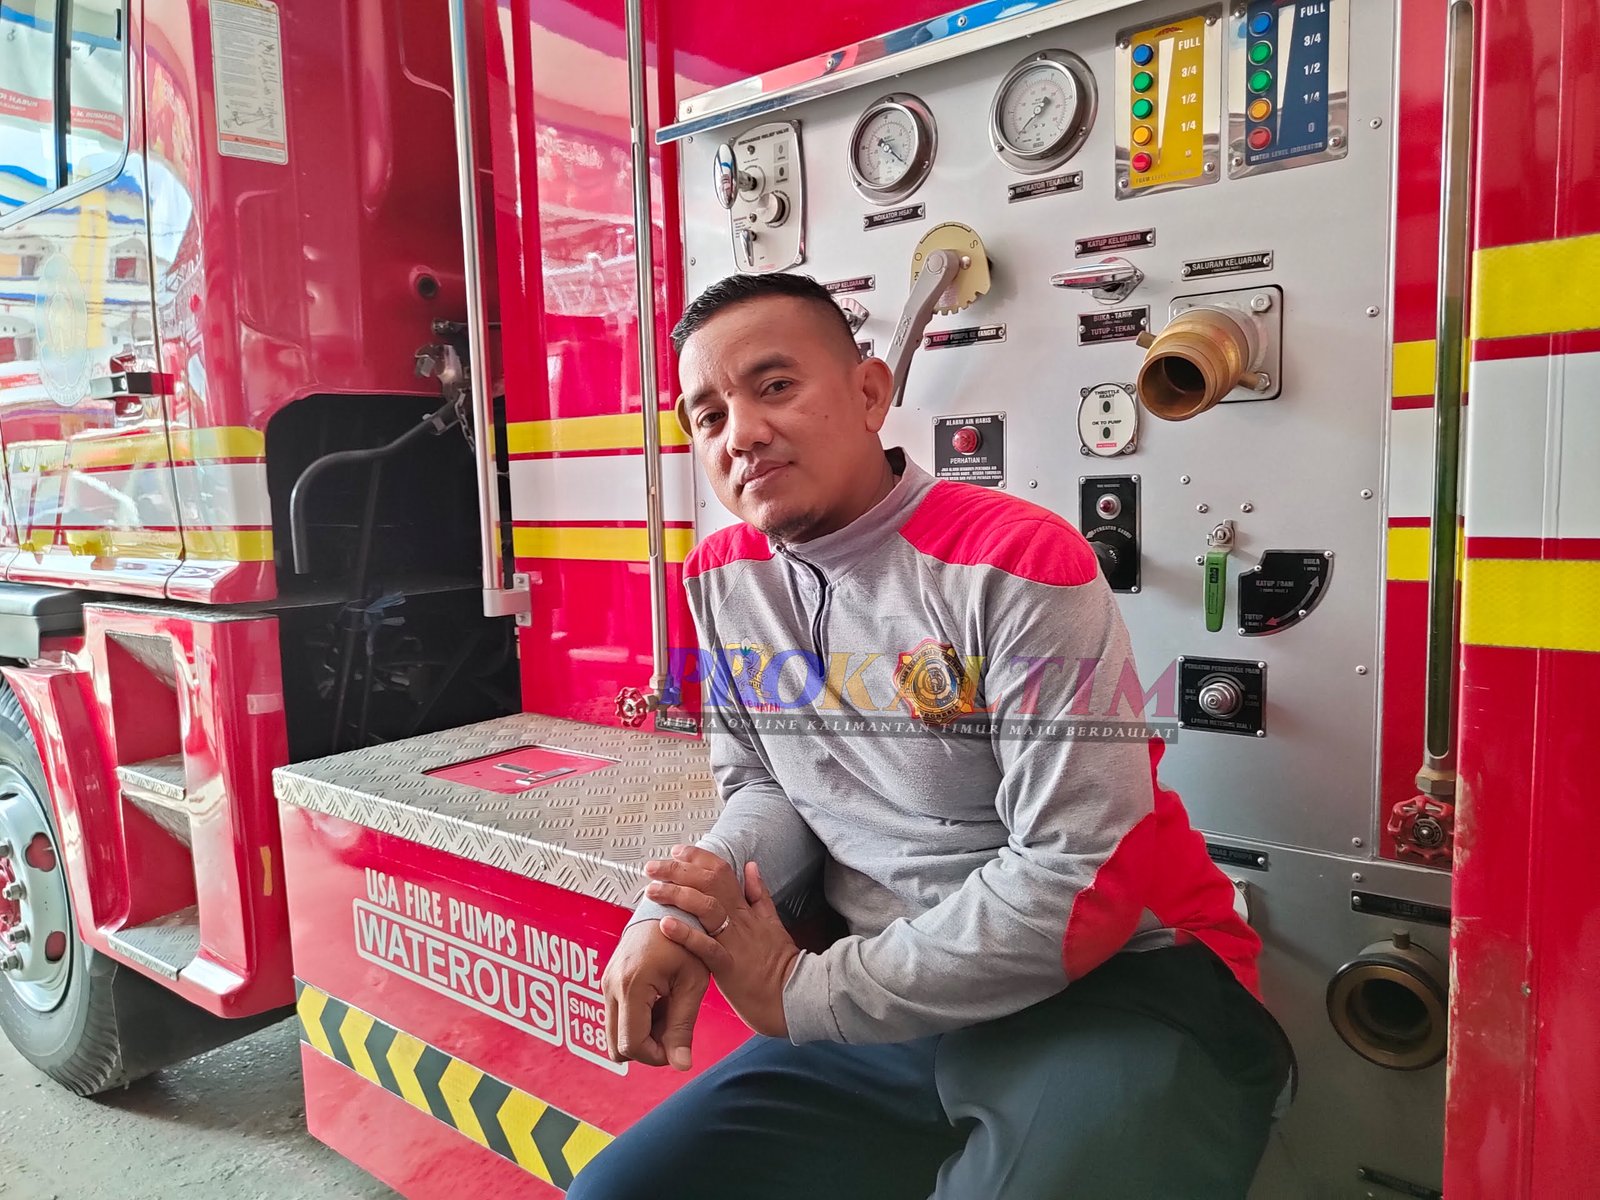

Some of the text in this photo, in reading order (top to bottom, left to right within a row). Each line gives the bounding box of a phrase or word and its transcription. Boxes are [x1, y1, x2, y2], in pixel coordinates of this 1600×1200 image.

[1300, 4, 1326, 18] FULL
[1178, 37, 1201, 50] FULL
[1303, 33, 1321, 46] 3/4
[1181, 65, 1197, 77] 3/4
[1303, 62, 1321, 76] 1/2
[1181, 93, 1197, 105] 1/2
[1303, 92, 1320, 104] 1/4
[776, 127, 789, 135] VALVE
[1181, 120, 1197, 132] 1/4
[1250, 153, 1270, 162] WATER
[1271, 149, 1288, 158] LEVEL
[1015, 181, 1046, 194] INDIKATOR
[1045, 175, 1073, 187] TEKANAN
[873, 211, 898, 222] INDIKATOR
[1087, 238, 1108, 248] KATUP
[1107, 233, 1141, 245] KELUARAN
[1191, 260, 1224, 271] SALURAN
[1224, 255, 1262, 266] KELUARAN
[1093, 313, 1110, 322] BUKA
[1114, 311, 1133, 319] TARIK
[1091, 327, 1111, 336] TUTUP
[1114, 324, 1136, 333] TEKAN
[365, 867, 602, 990] USA FIRE PUMPS INSIDE
[359, 909, 555, 1031] WATEROUS
[569, 997, 606, 1027] SINC
[571, 1018, 608, 1052] 188
